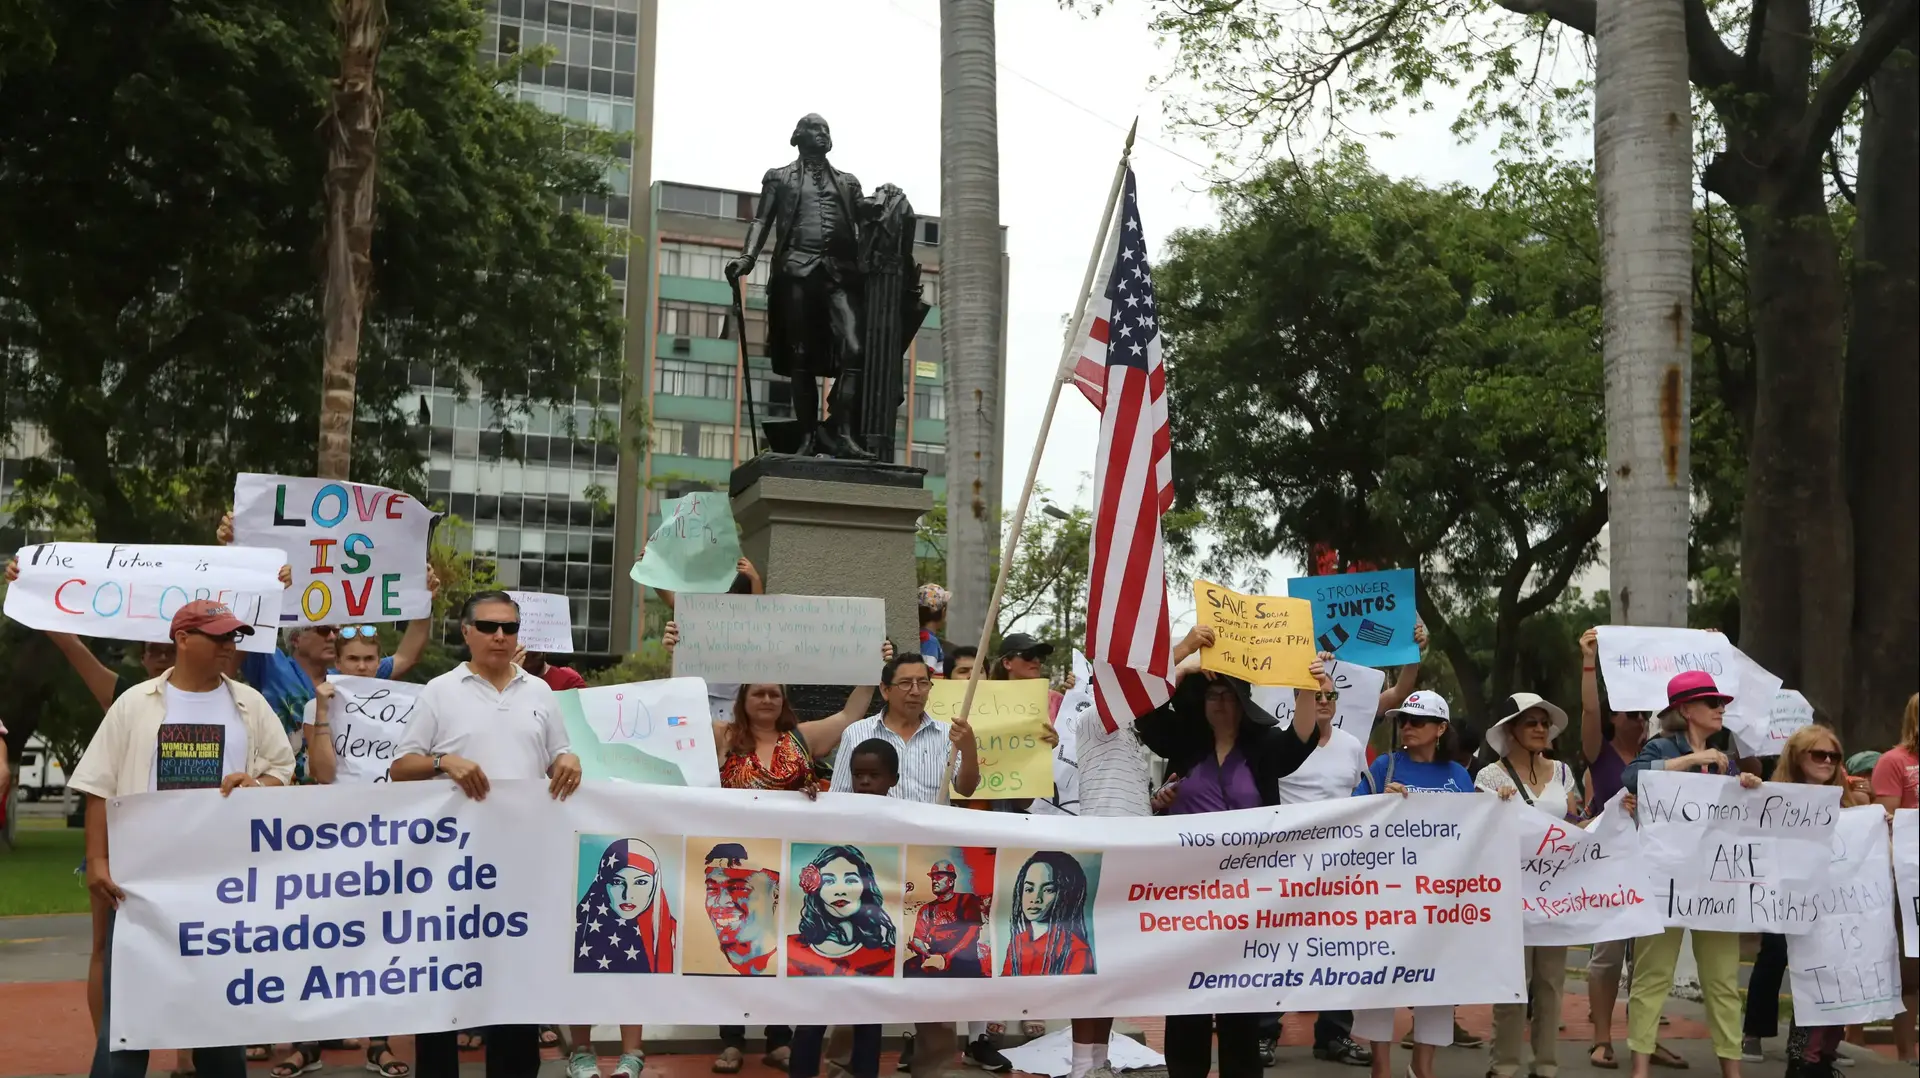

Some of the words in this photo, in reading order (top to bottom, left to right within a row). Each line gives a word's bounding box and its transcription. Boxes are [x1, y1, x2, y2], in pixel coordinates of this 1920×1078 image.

[273, 483, 410, 528] LOVE
[31, 543, 75, 569] The
[106, 544, 163, 569] Future
[195, 559, 209, 572] is
[310, 532, 374, 574] IS
[279, 573, 402, 622] OVE
[1206, 589, 1248, 619] SAVE
[1316, 581, 1391, 602] STRONGER
[1326, 593, 1396, 619] JUNTOS
[821, 619, 845, 633] and
[1262, 620, 1289, 629] NEA
[1286, 634, 1310, 646] PPH
[1242, 653, 1272, 671] USA
[927, 693, 1041, 716] erchos
[161, 742, 195, 751] WOMEN'S
[195, 742, 220, 751] RIGHTS
[161, 750, 174, 758] ARE
[175, 750, 197, 758] HUMAN
[198, 750, 219, 758] RIGHTS
[334, 723, 399, 760] dere
[161, 759, 177, 767] NO
[179, 759, 220, 768] HUMAN
[161, 766, 170, 775] IS
[174, 766, 218, 775] ILLEGAL
[1641, 783, 1751, 824] Women's
[1759, 794, 1833, 829] Rights
[250, 813, 471, 853] Nosotros,
[1179, 831, 1215, 849] Nos
[1221, 821, 1364, 848] comprometemos
[1369, 824, 1380, 838] a
[1384, 818, 1462, 841] celebrar,
[1218, 850, 1297, 872] defender
[1302, 853, 1313, 870] y
[1320, 848, 1397, 872] proteger
[1401, 846, 1418, 866] la
[1709, 843, 1767, 882] ARE
[216, 867, 257, 905] el
[275, 858, 433, 910] pueblo
[447, 855, 497, 891] de
[1127, 877, 1250, 902] Diversidad
[1279, 873, 1379, 899] Inclusión
[1415, 873, 1502, 898] Respeto
[1536, 884, 1645, 919] Resistencia
[1654, 877, 1737, 919] Human
[1749, 883, 1820, 924] Rights
[1821, 881, 1891, 914] UMAN
[178, 913, 366, 957] Estados
[382, 904, 529, 945] Unidos
[1139, 909, 1250, 933] Derechos
[1255, 906, 1358, 930] Humanos
[1364, 907, 1417, 931] para
[1423, 902, 1492, 926] Tod@s
[1243, 939, 1281, 963] Hoy
[1287, 943, 1299, 963] y
[1306, 936, 1397, 961] Siempre.
[1839, 922, 1863, 950] is
[226, 968, 285, 1006] de
[300, 956, 483, 1001] América
[1187, 970, 1304, 990] Democrats
[1309, 965, 1387, 986] Abroad
[1391, 964, 1436, 984] Peru
[1804, 960, 1900, 1005] ILLE
